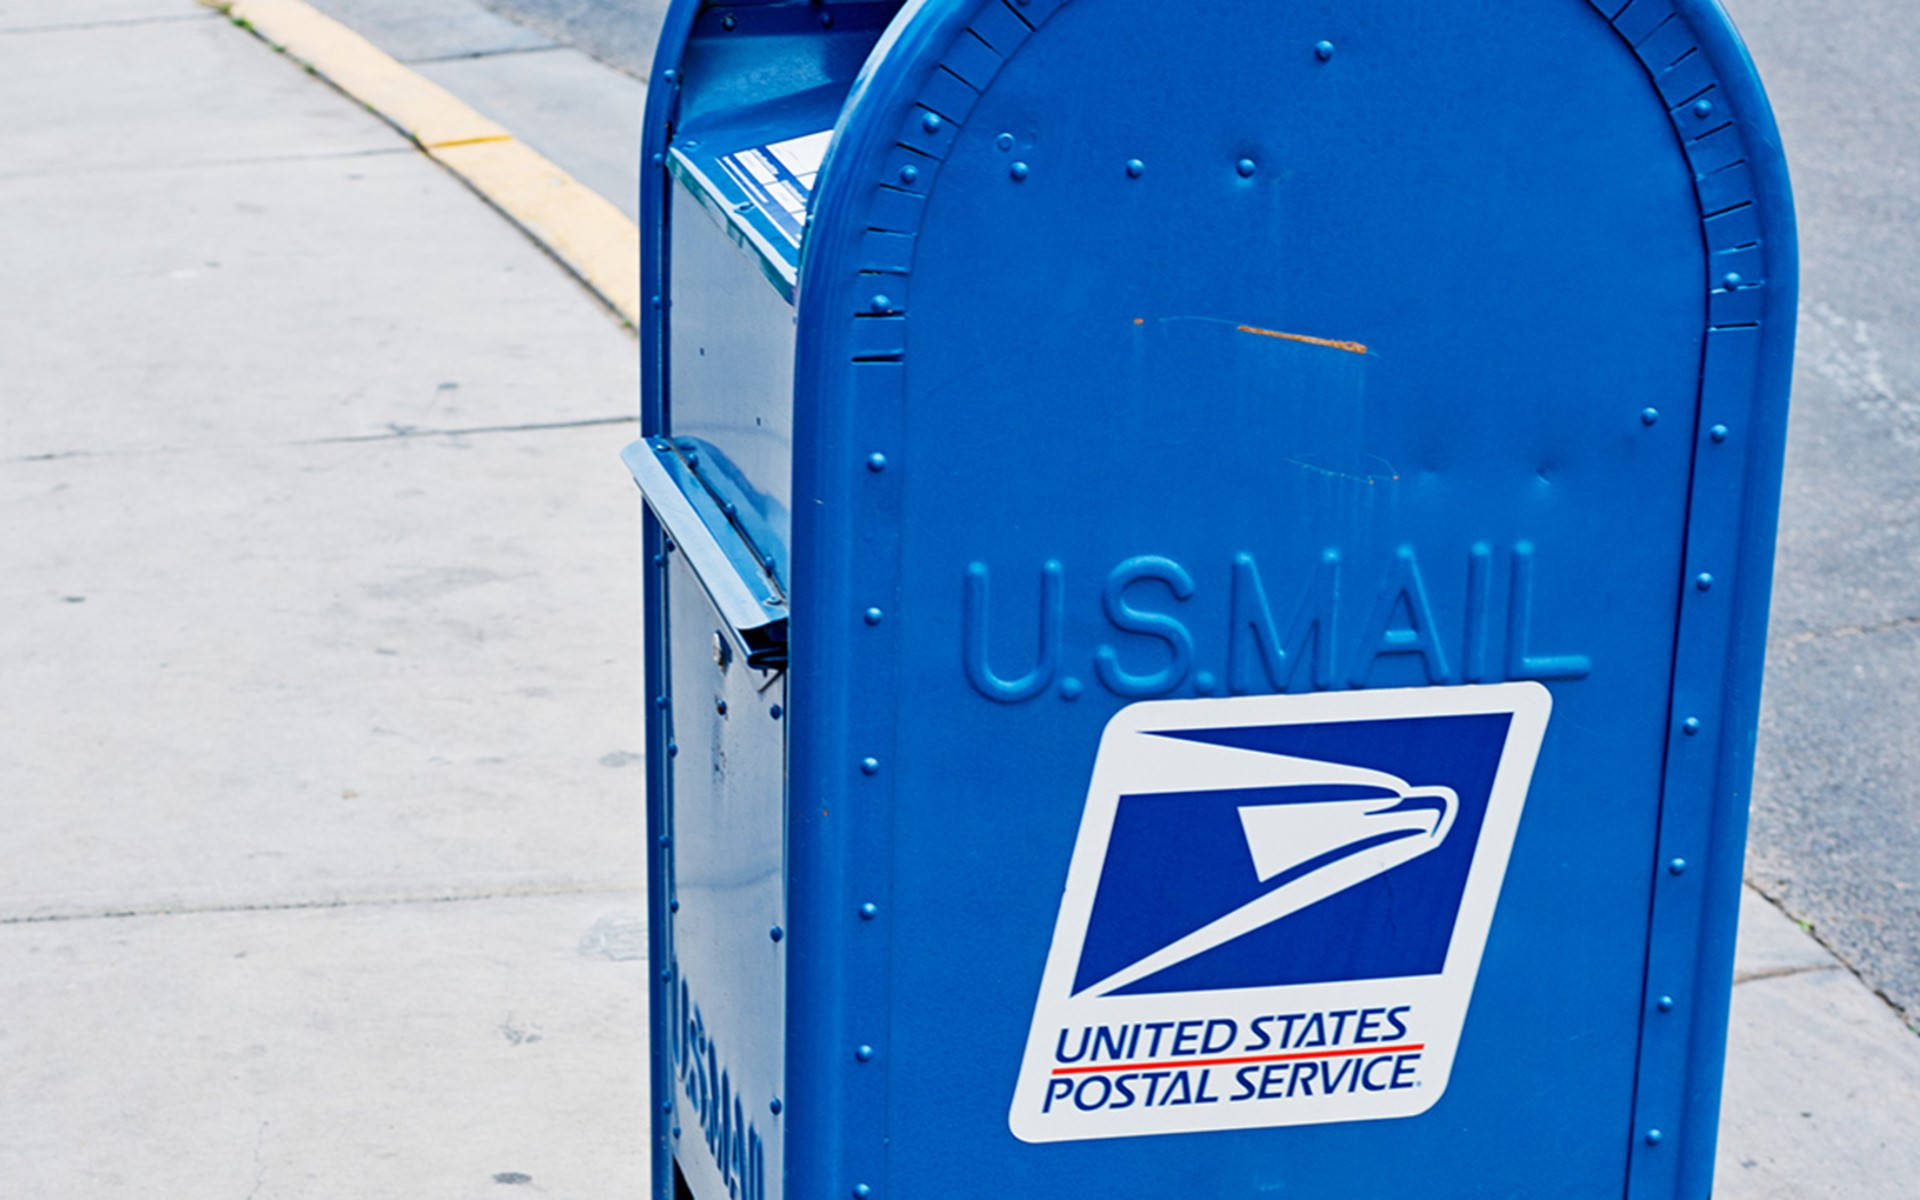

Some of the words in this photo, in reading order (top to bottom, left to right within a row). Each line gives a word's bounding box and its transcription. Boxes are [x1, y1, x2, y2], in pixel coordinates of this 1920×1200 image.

[1055, 1018, 1238, 1064] UNITED
[1244, 1005, 1411, 1053] STATES
[1042, 1069, 1220, 1114] POSTAL
[1230, 1053, 1422, 1102] SERVICE
